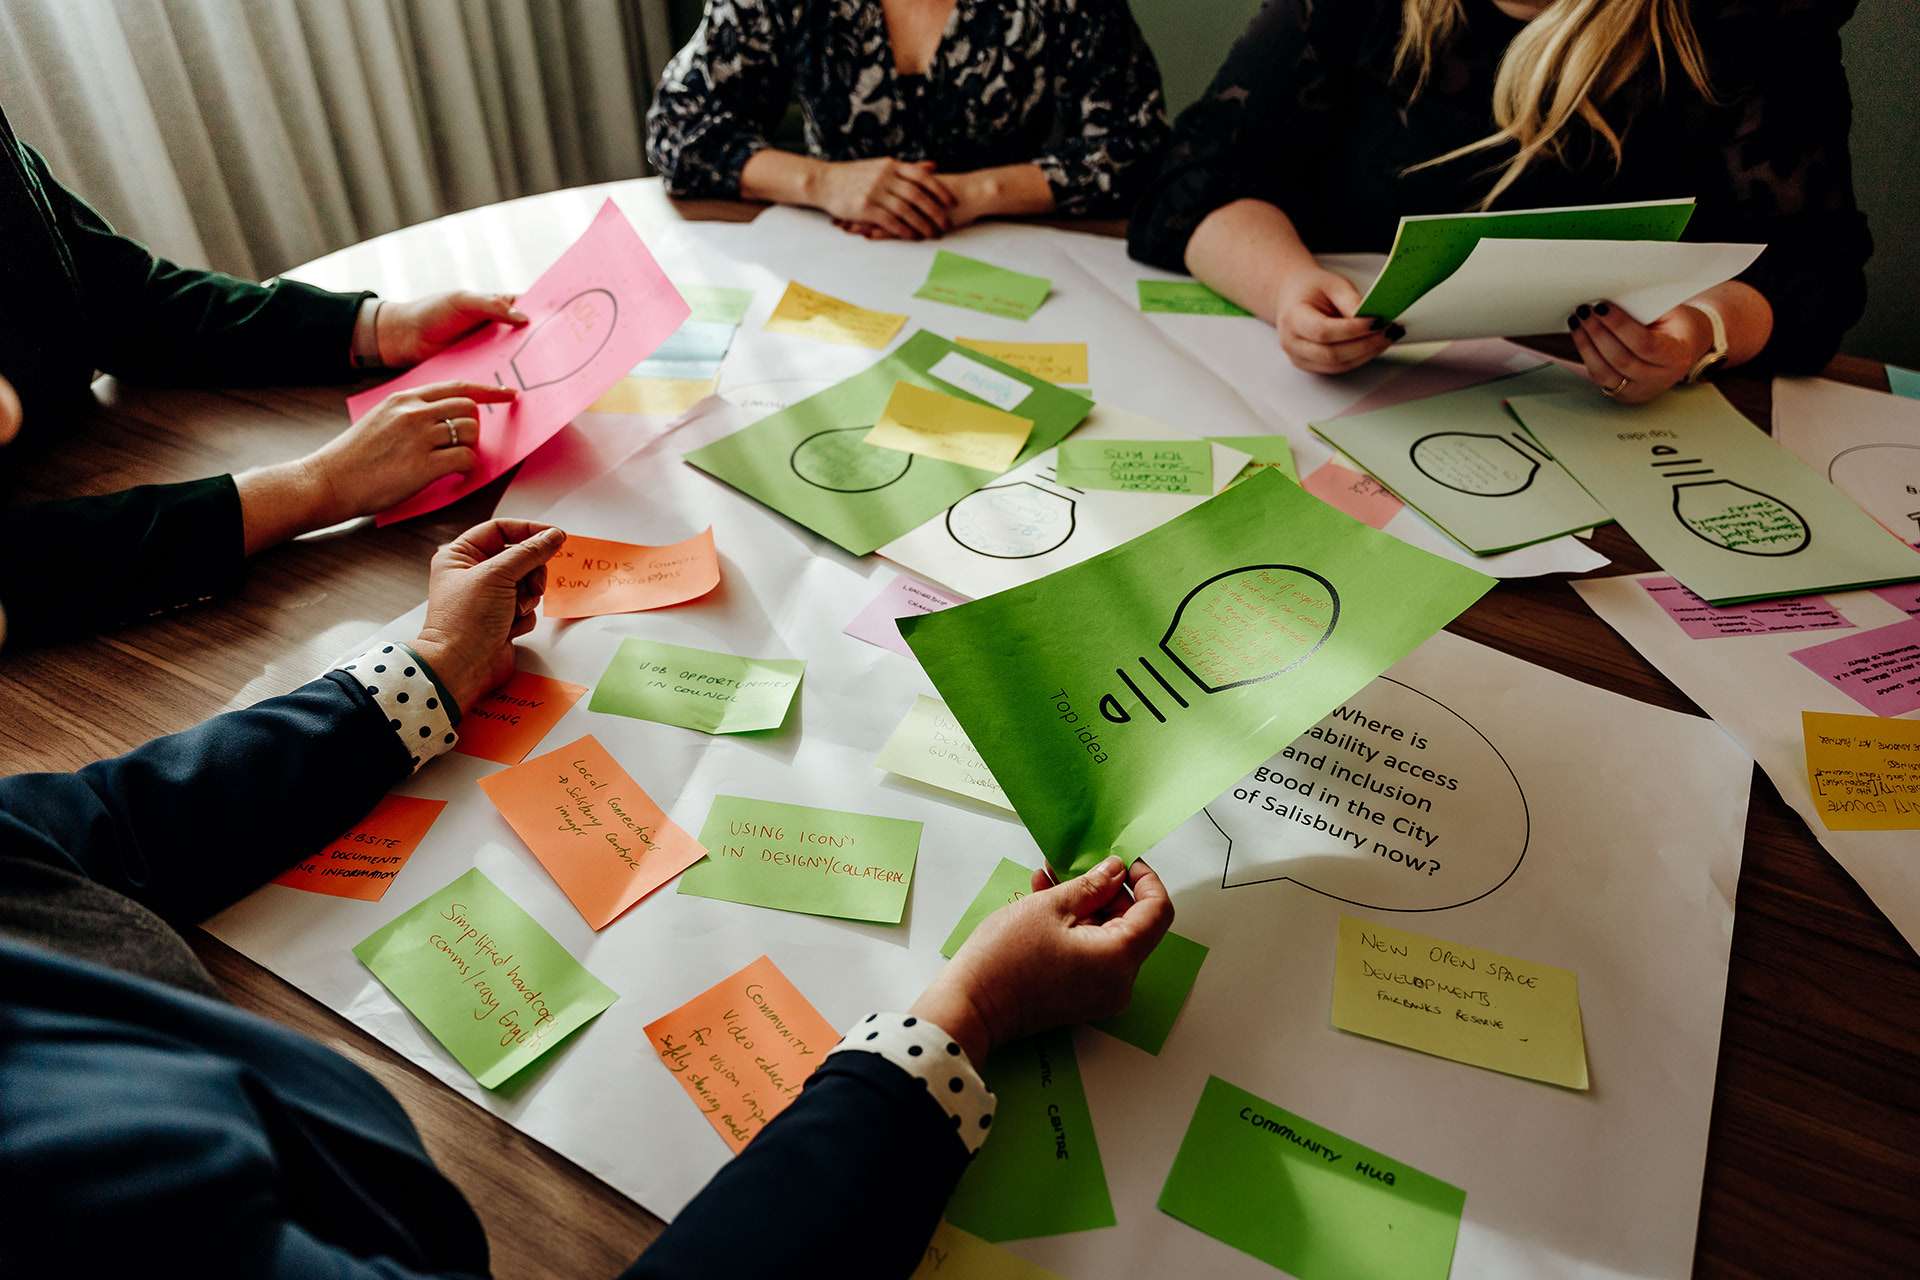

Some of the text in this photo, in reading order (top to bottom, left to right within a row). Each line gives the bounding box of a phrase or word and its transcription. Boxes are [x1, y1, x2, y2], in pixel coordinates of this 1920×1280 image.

[556, 576, 591, 588] RUN
[582, 558, 635, 572] NDIS
[649, 681, 738, 703] IN COUNCIL
[1050, 688, 1109, 765] Top idea
[1333, 705, 1428, 750] Where is
[1282, 746, 1433, 813] and inclusion
[1304, 727, 1459, 791] ability access
[572, 759, 662, 852] Local Connections
[730, 820, 785, 841] USING
[1233, 787, 1441, 877] of Salisbury now?
[1254, 766, 1440, 848] good in the City
[1828, 800, 1889, 814] EDUCATE
[320, 866, 400, 880] INFORMATION
[331, 850, 401, 864] DOCUMENTS
[721, 845, 745, 859] IN
[440, 903, 514, 967] Simplified
[1361, 932, 1540, 989] NEW OPEN SPACE
[745, 984, 814, 1056] COMMUNITY
[1377, 990, 1504, 1030] FAIRBANKS RESERVE
[689, 1027, 767, 1125] for vision impa
[755, 1056, 800, 1101] educati
[1047, 1103, 1069, 1161] CENTRE
[1239, 1106, 1395, 1186] COMMUNITY HUB
